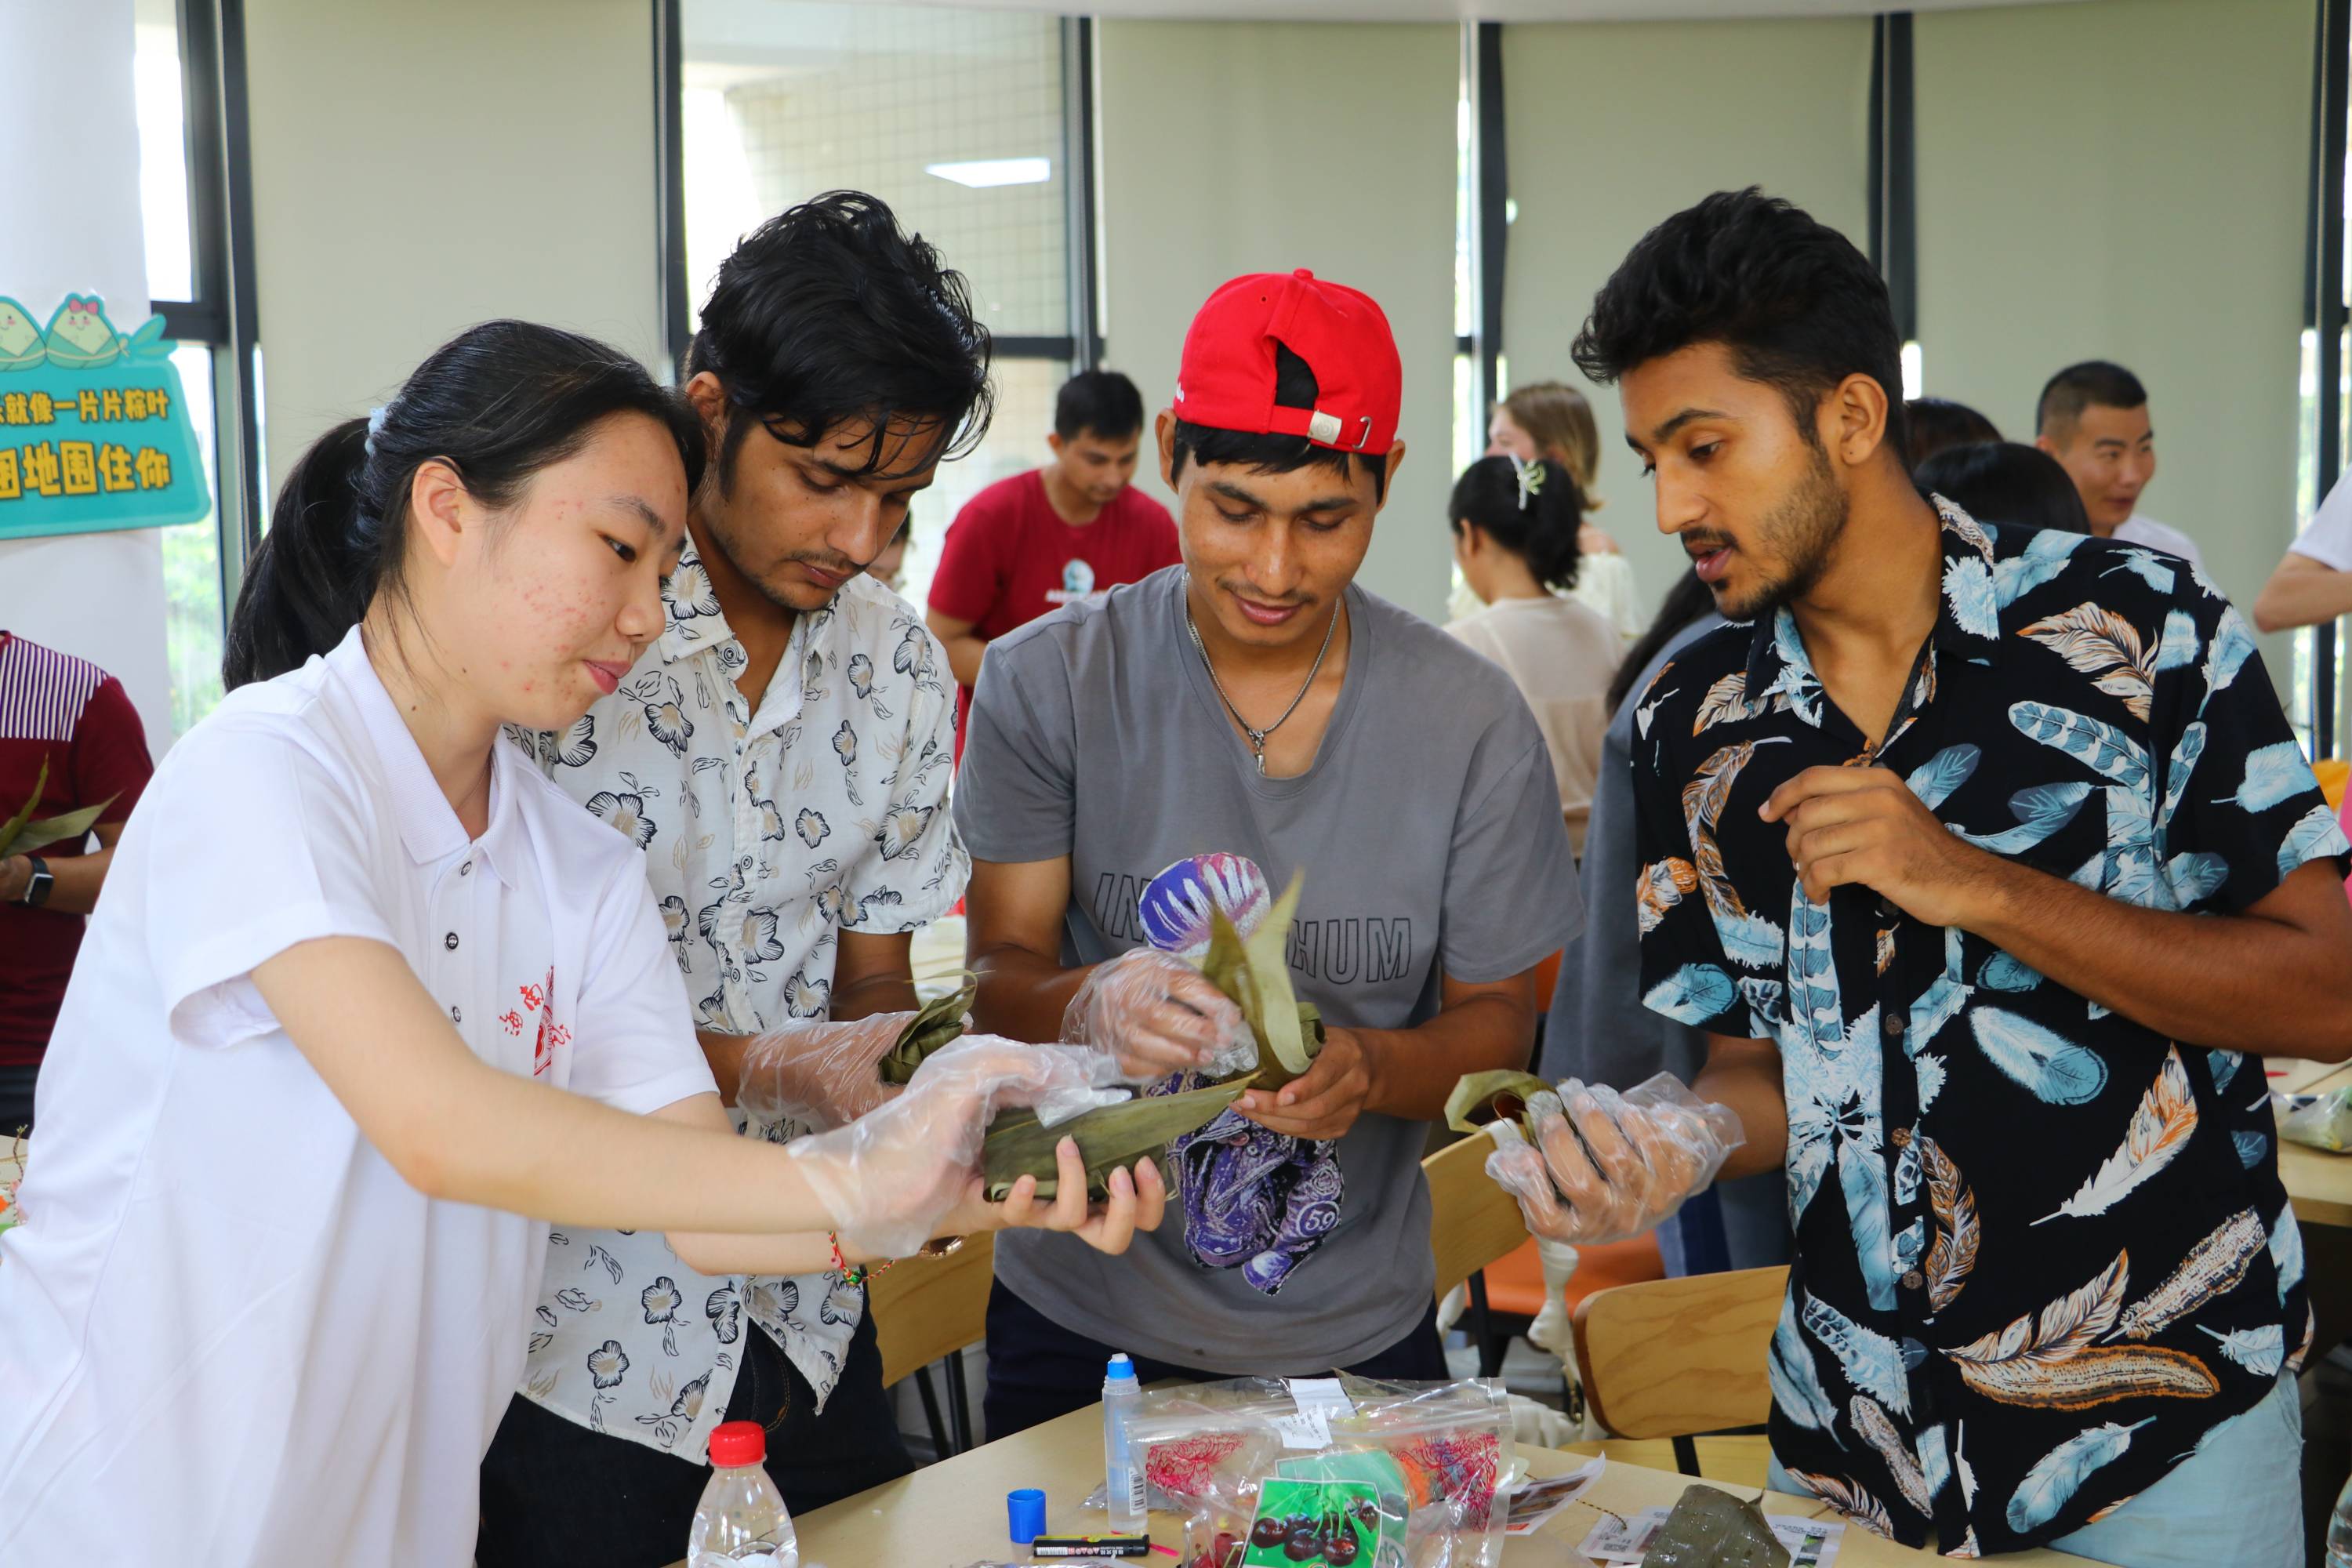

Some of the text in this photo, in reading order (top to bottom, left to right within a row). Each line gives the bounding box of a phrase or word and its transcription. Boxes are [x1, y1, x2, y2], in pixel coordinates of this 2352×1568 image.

[0, 388, 169, 425] 就像一片片粽叶
[1305, 1209, 1336, 1231] 59
